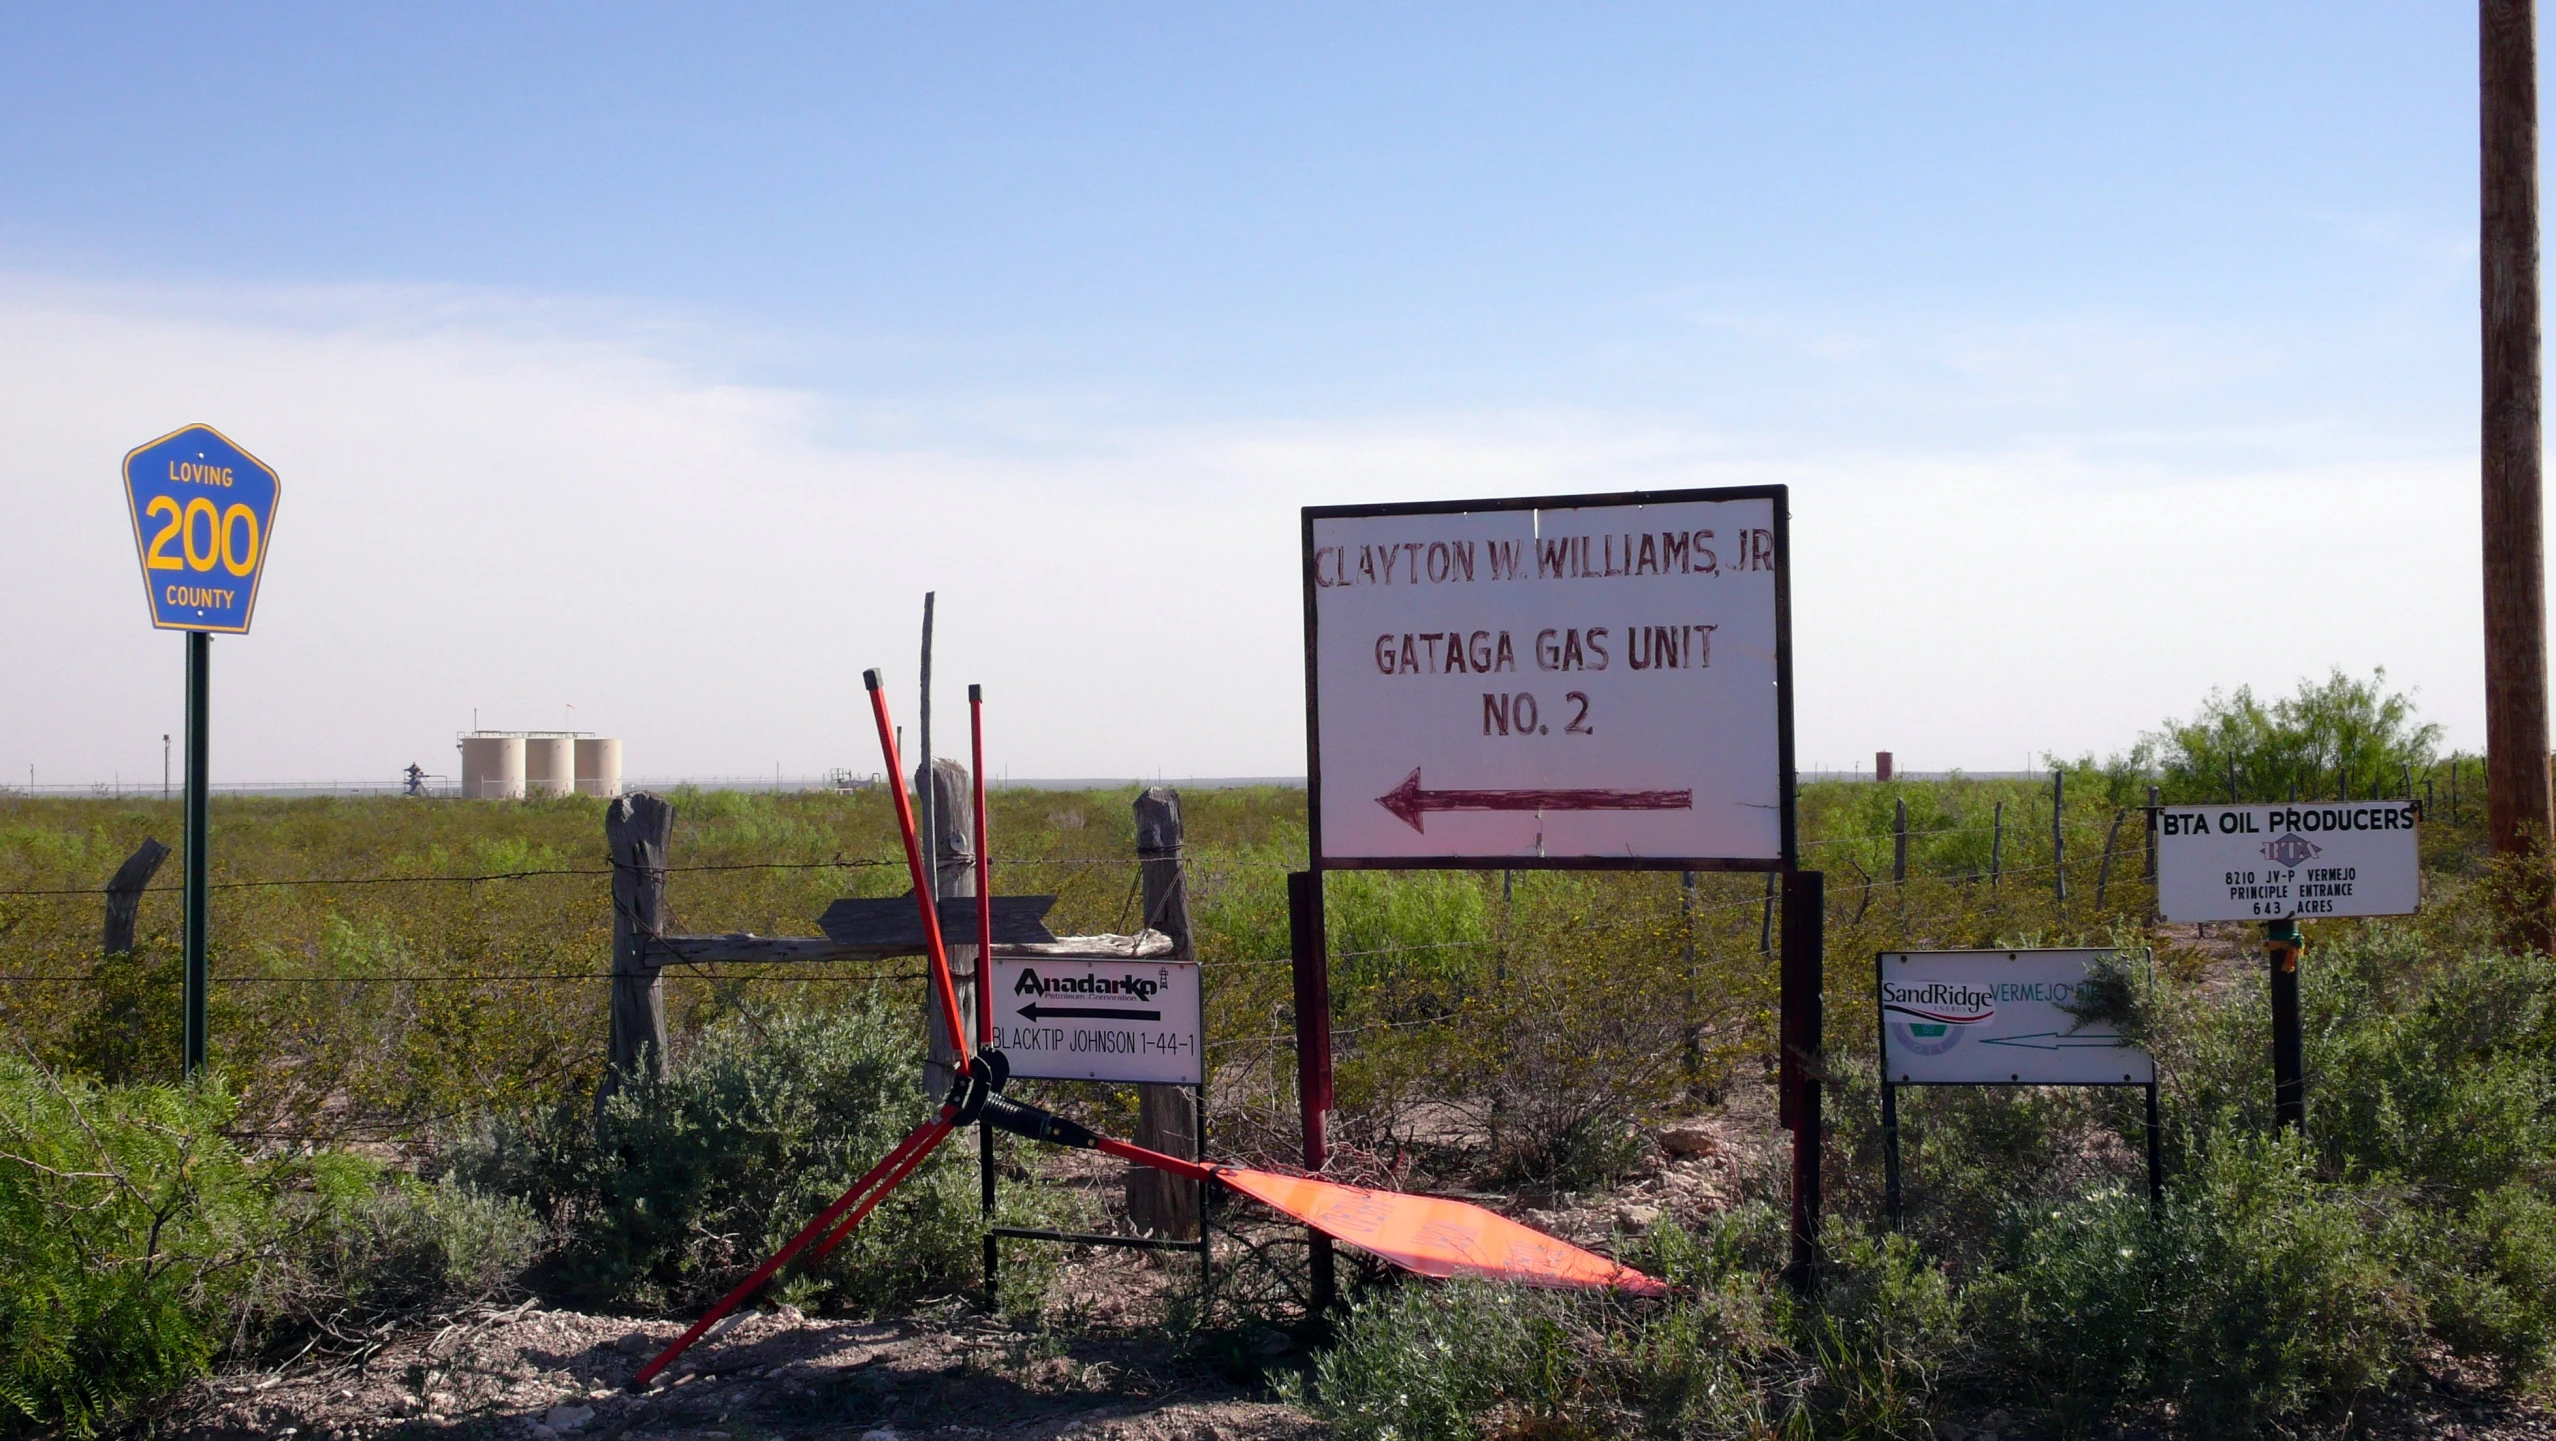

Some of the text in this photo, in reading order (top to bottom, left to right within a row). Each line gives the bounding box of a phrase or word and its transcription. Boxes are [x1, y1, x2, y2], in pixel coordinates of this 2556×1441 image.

[169, 461, 233, 487] LOVING
[146, 495, 259, 577] 200
[1314, 540, 1475, 588] CLAYTON
[1535, 528, 1720, 579] WILLIAMS,
[1726, 528, 1775, 573] JR
[166, 585, 235, 609] COUNTY
[1375, 624, 1718, 675] GATAGA GAS UNIT
[1482, 691, 1594, 737] NO. 2
[2163, 808, 2414, 836] BTA OIL PRODUCERS
[2261, 840, 2320, 861] BTA
[2225, 867, 2356, 885] 8210 JV-P VERMEJO
[2230, 883, 2353, 900] PRINCIPLE ENTRANCE
[2297, 899, 2333, 914] ACRES
[1014, 967, 1157, 1001] Anadarko
[1044, 992, 1085, 1000] Petroleum
[1989, 983, 2068, 1002] VERMEJO
[1883, 982, 1993, 1013] SandRidge
[1933, 1005, 1968, 1013] ENERGY
[992, 1026, 1195, 1056] BLACKTIP JOHNSON 1-44-1
